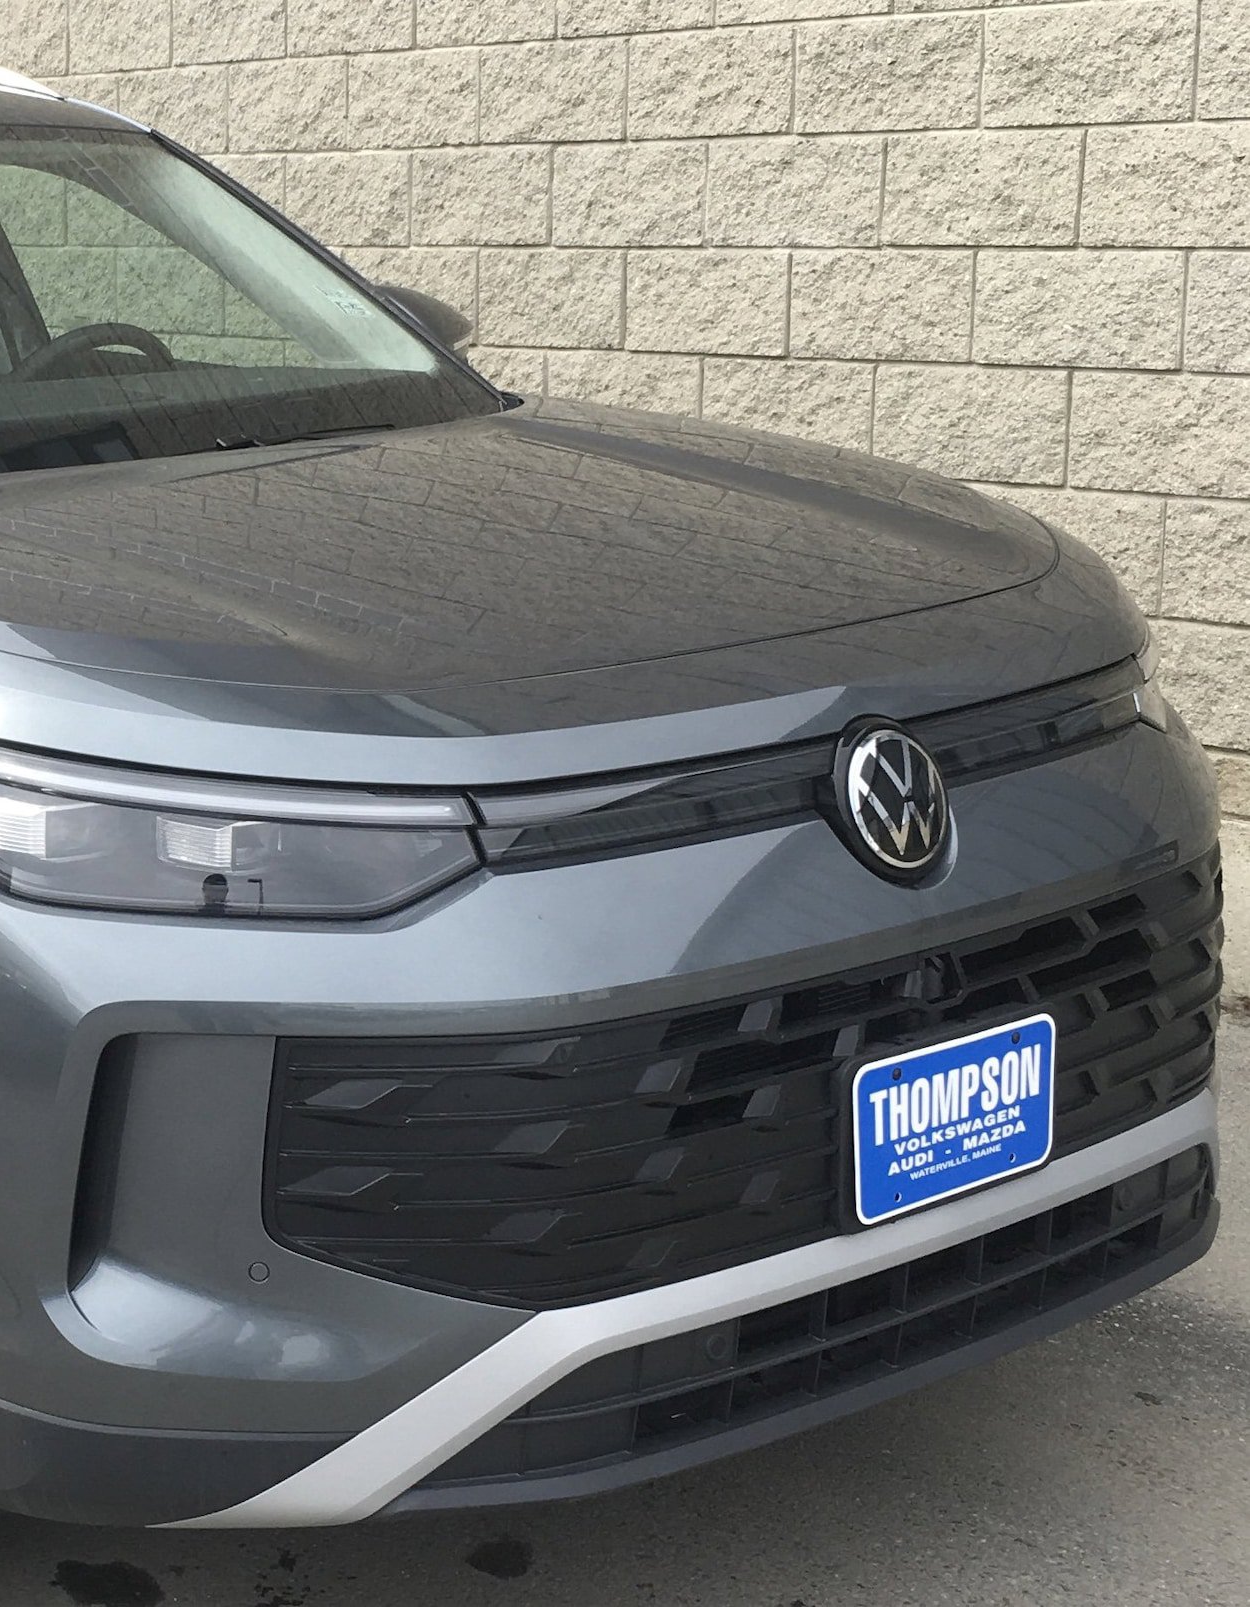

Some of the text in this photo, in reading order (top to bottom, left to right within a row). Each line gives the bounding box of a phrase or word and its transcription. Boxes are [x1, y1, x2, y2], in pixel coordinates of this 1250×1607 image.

[849, 731, 946, 867] VW
[869, 1043, 1041, 1146] THOMPSON
[888, 1150, 934, 1176] AUDI
[963, 1120, 1026, 1151] MAZDA
[894, 1105, 1020, 1155] VOLKSWAGEN
[972, 1143, 1002, 1161] MAINE
